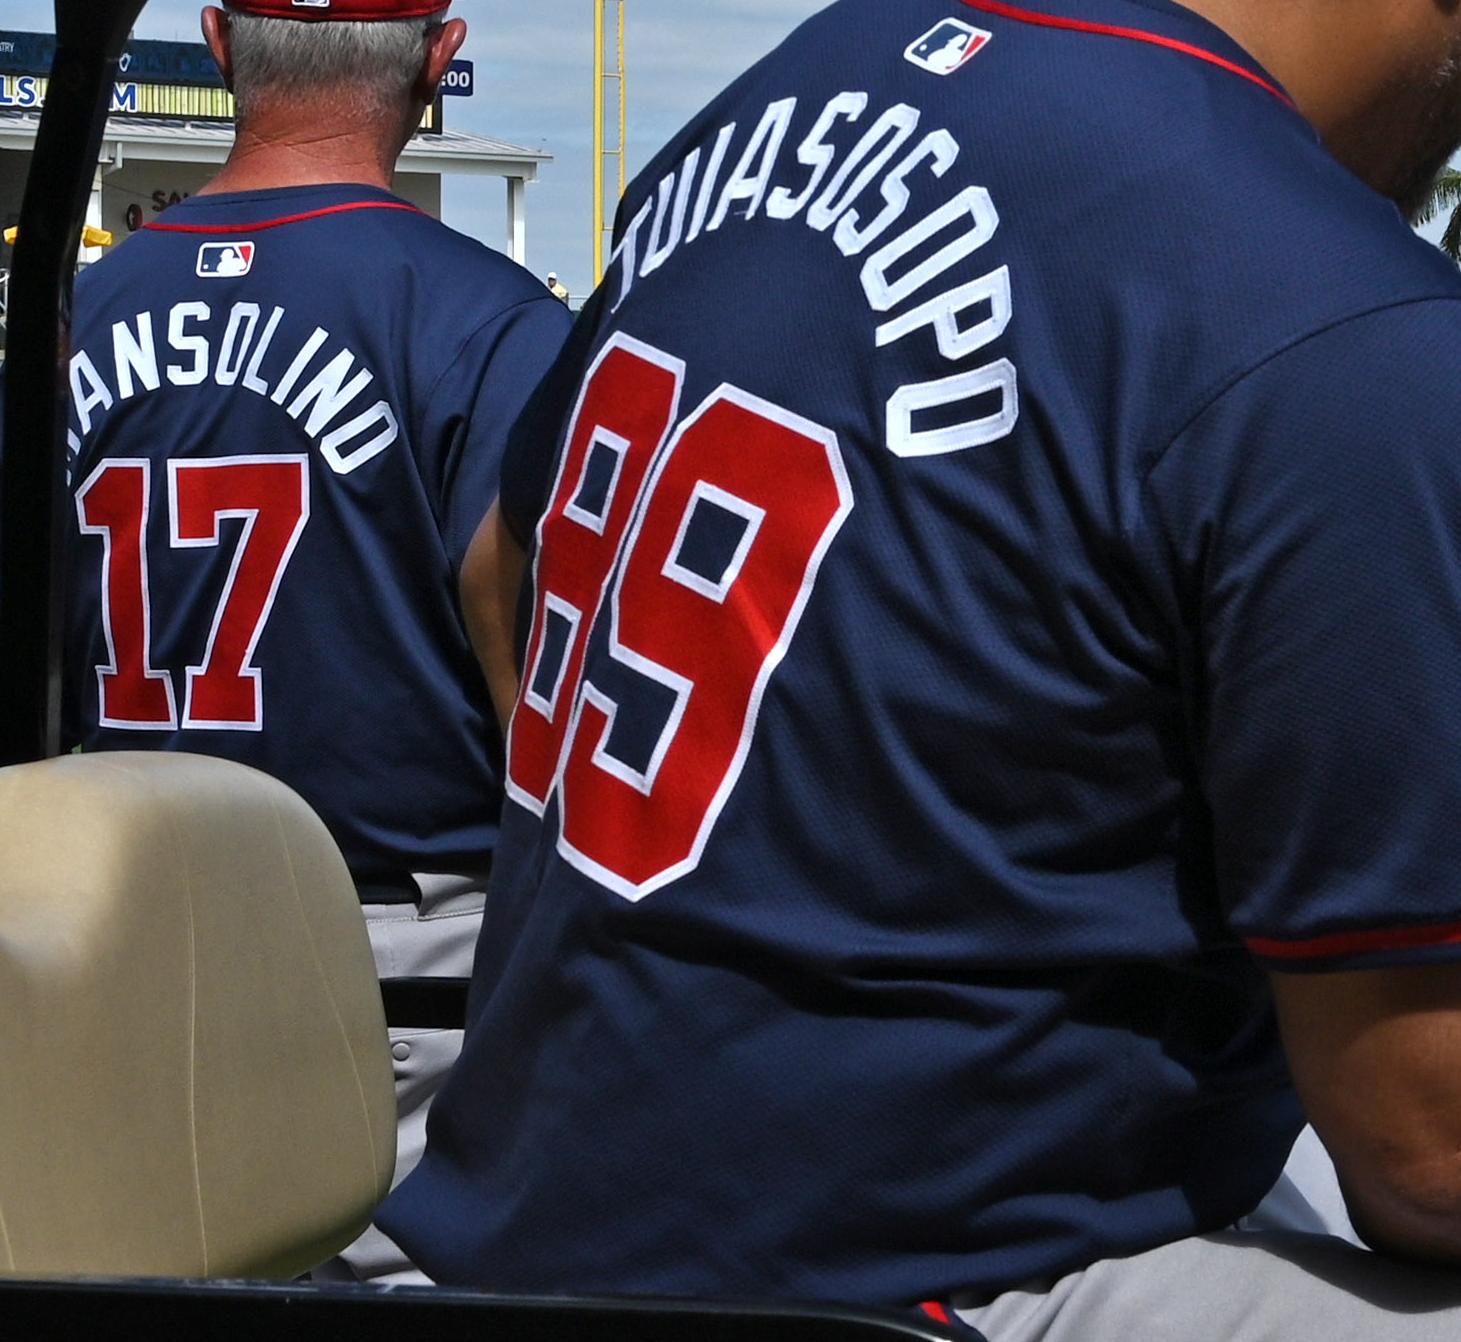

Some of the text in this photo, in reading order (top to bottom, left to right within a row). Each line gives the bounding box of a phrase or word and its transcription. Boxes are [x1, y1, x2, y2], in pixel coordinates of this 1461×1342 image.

[67, 300, 400, 487] ANSOLINO
[610, 91, 1018, 458] TUIASOSOPO
[75, 454, 309, 731] 17
[506, 331, 855, 903] 89
